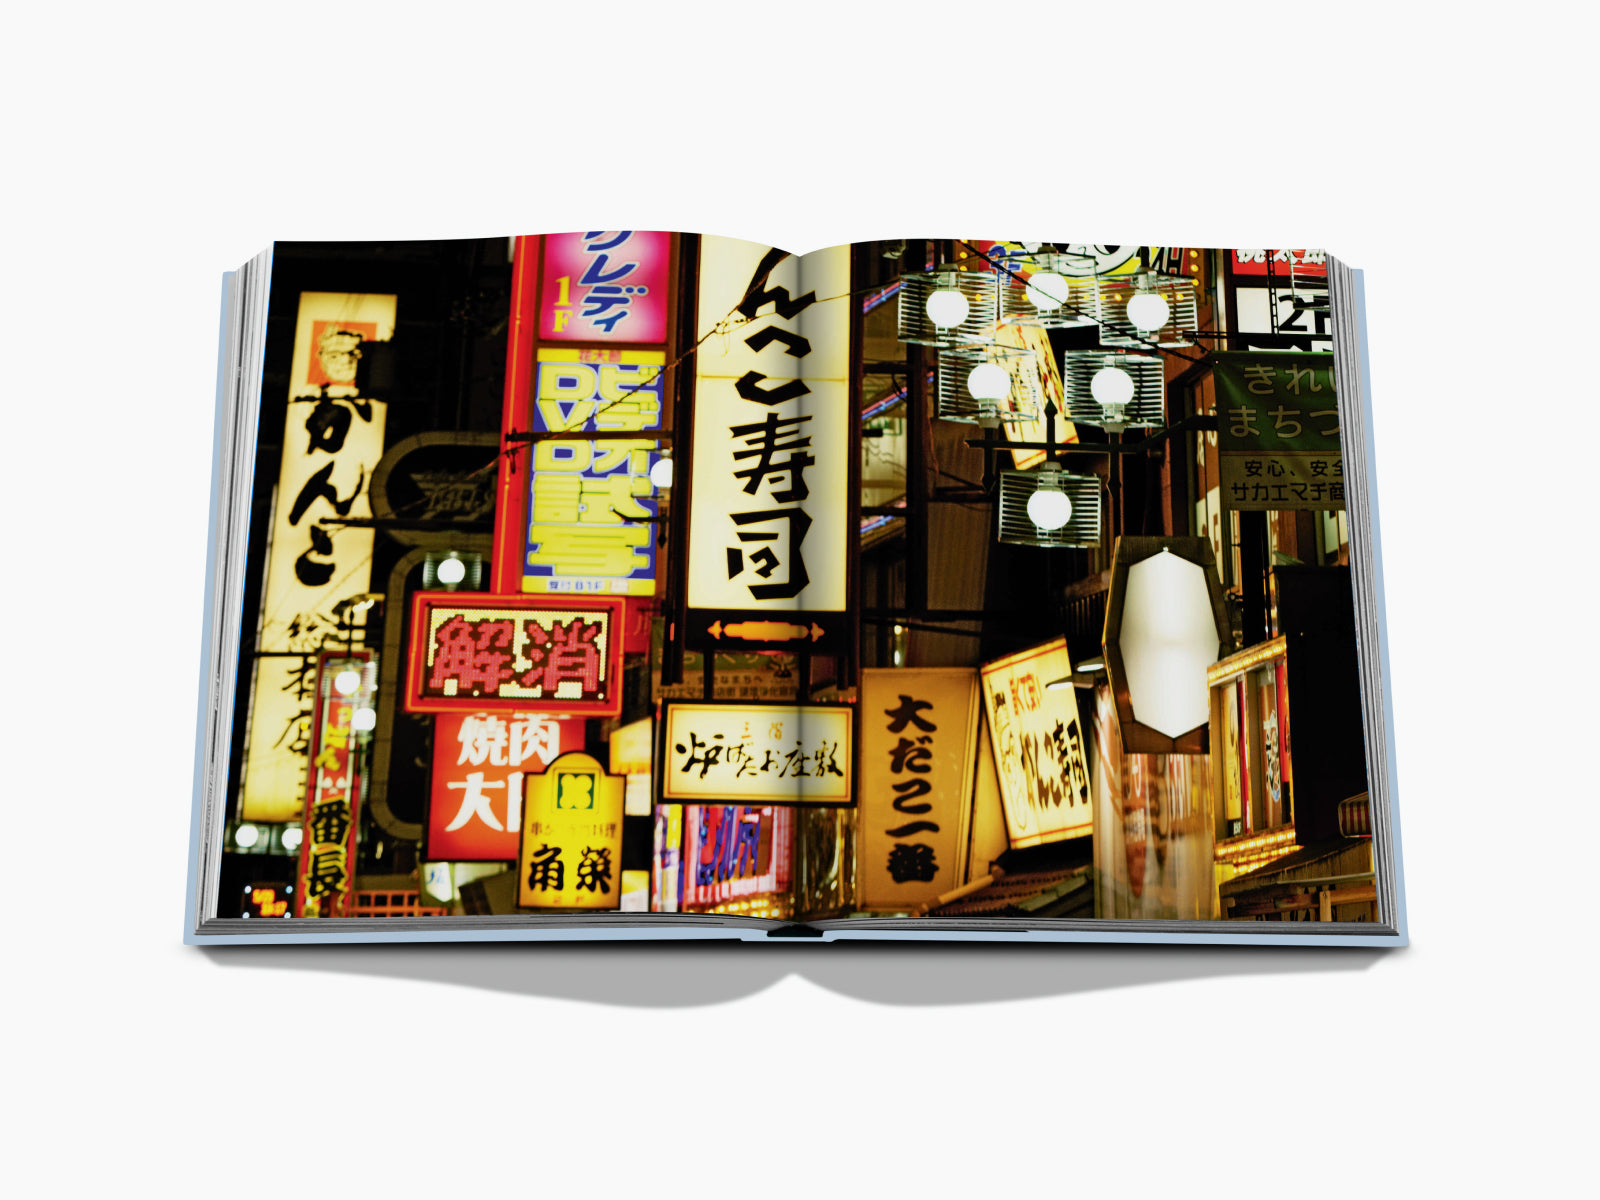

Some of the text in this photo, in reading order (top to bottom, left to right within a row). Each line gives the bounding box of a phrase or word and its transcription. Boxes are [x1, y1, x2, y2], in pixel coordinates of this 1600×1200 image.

[429, 614, 599, 693] 解消
[457, 713, 561, 767] 焼肉
[445, 771, 524, 834] 大
